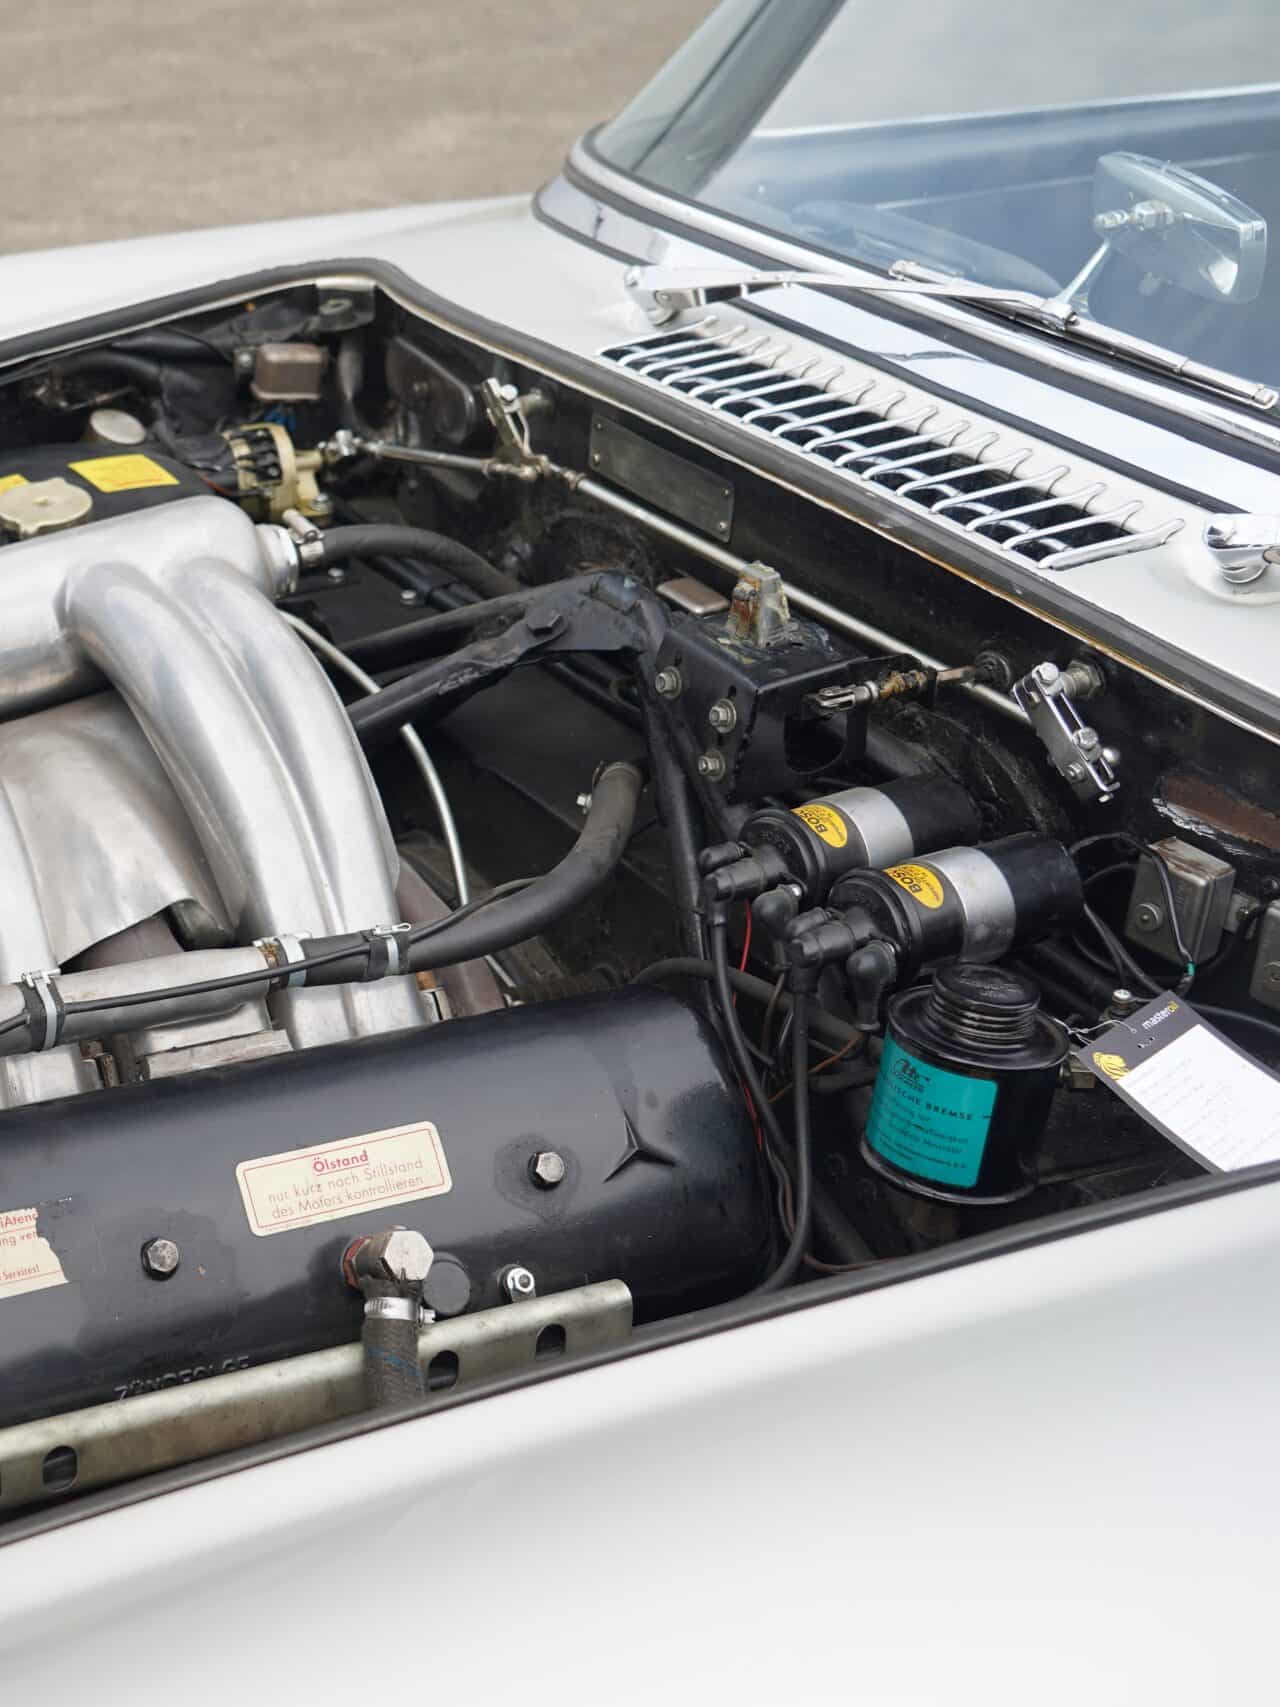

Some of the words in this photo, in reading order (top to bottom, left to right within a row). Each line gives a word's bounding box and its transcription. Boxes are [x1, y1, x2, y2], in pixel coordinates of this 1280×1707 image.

[926, 1103, 974, 1121] BREMSE
[313, 1149, 369, 1173] Ölstand
[269, 1191, 289, 1204] nur
[293, 1181, 322, 1199] kurz
[328, 1171, 360, 1189] nach
[364, 1158, 424, 1181] Stillstand
[271, 1204, 295, 1219] des
[298, 1192, 344, 1212] Motors
[346, 1176, 424, 1202] kontrollieren
